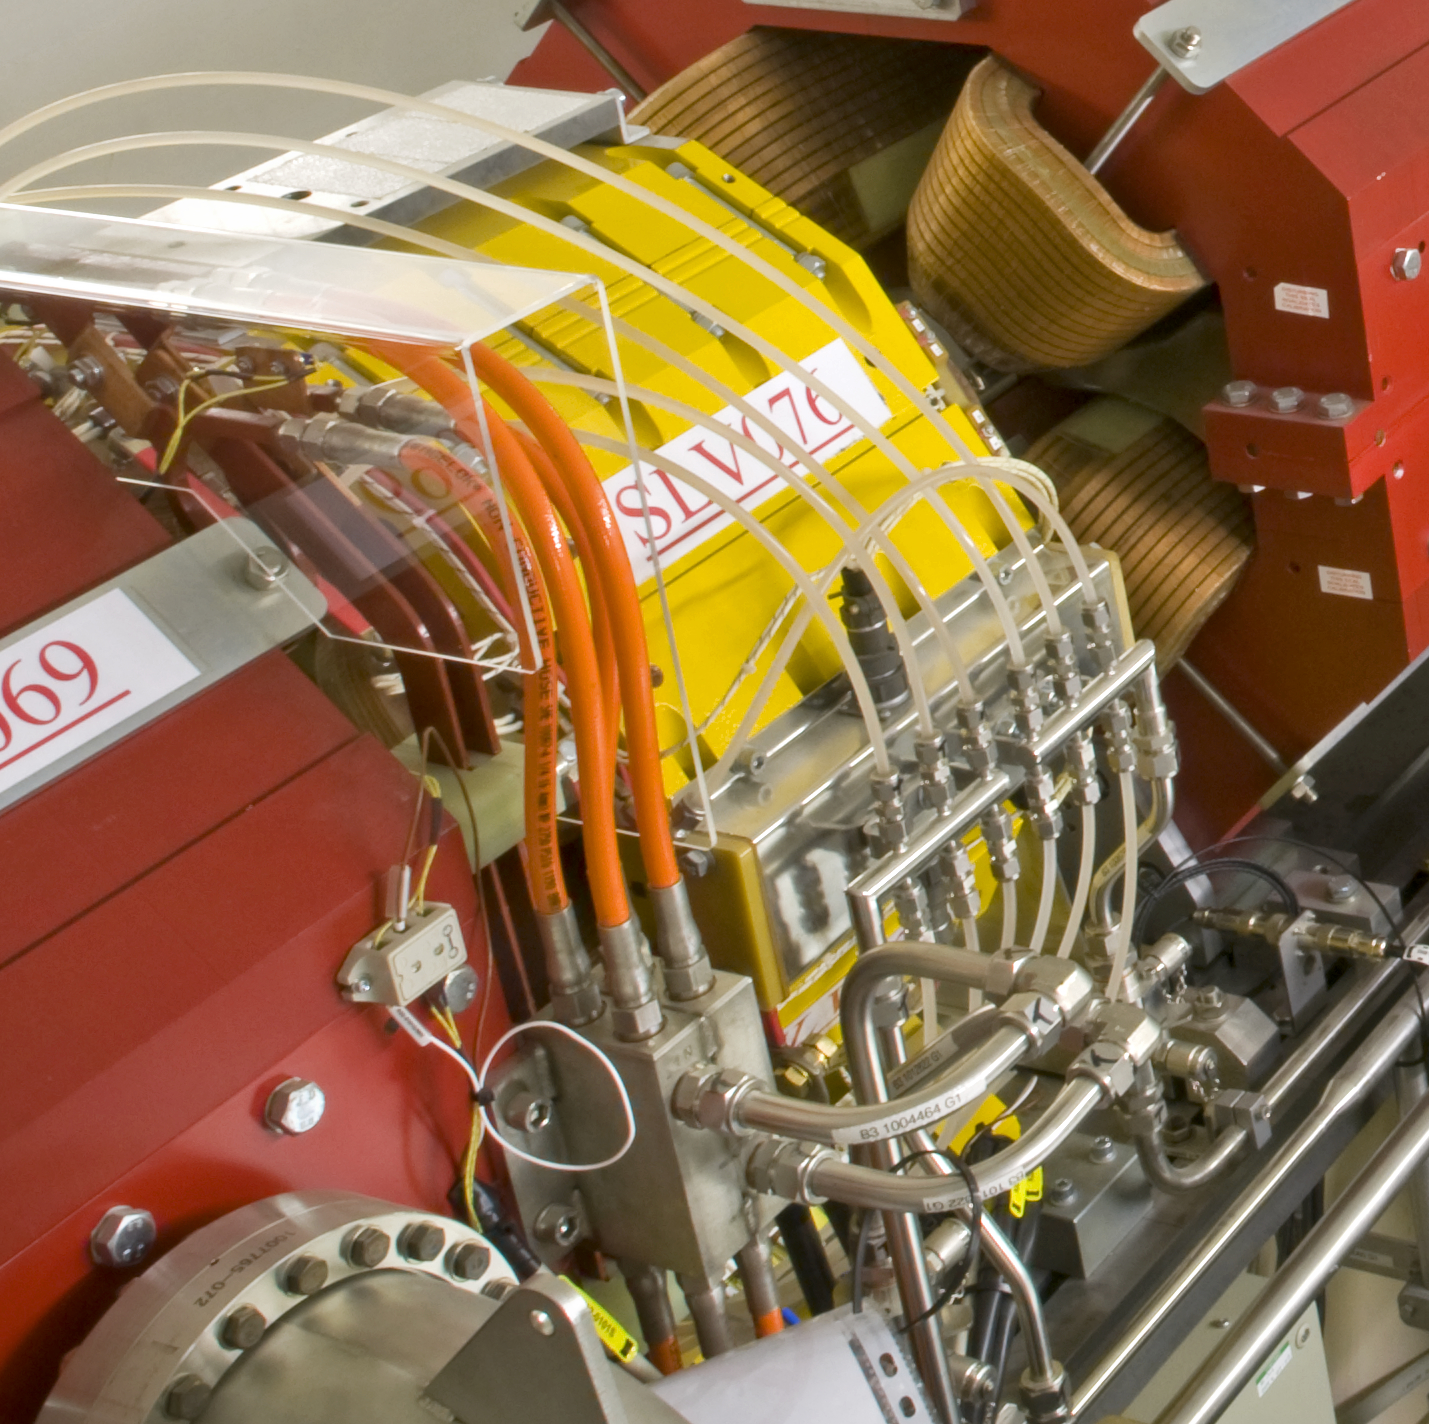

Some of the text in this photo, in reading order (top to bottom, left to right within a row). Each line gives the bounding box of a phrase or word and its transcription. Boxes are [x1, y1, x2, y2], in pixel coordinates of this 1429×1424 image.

[860, 1094, 962, 1140] B3 1004464 G1
